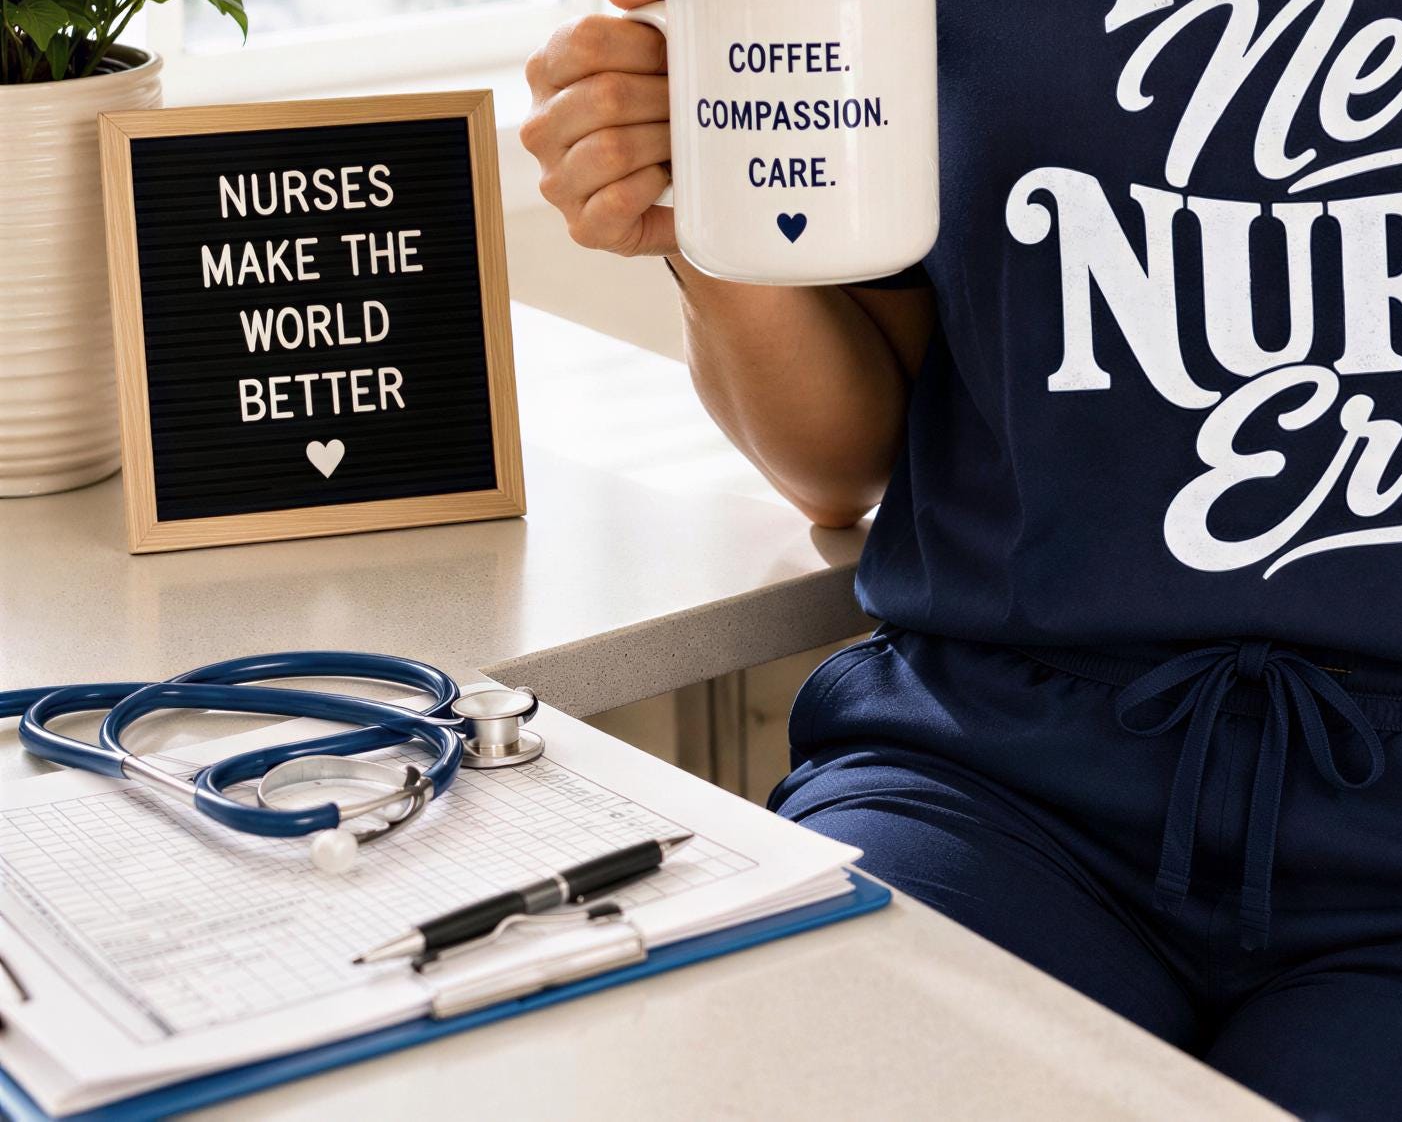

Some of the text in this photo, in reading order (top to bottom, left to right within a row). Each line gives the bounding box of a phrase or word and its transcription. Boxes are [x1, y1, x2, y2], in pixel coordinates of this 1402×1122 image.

[728, 42, 850, 74] COFFEE.
[696, 97, 888, 131] COMPASSION.
[219, 164, 394, 219] NURSES
[748, 157, 836, 188] CARE.
[201, 229, 424, 289] MAKE THE
[239, 300, 390, 353] WORLD
[238, 366, 406, 423] BETTER
